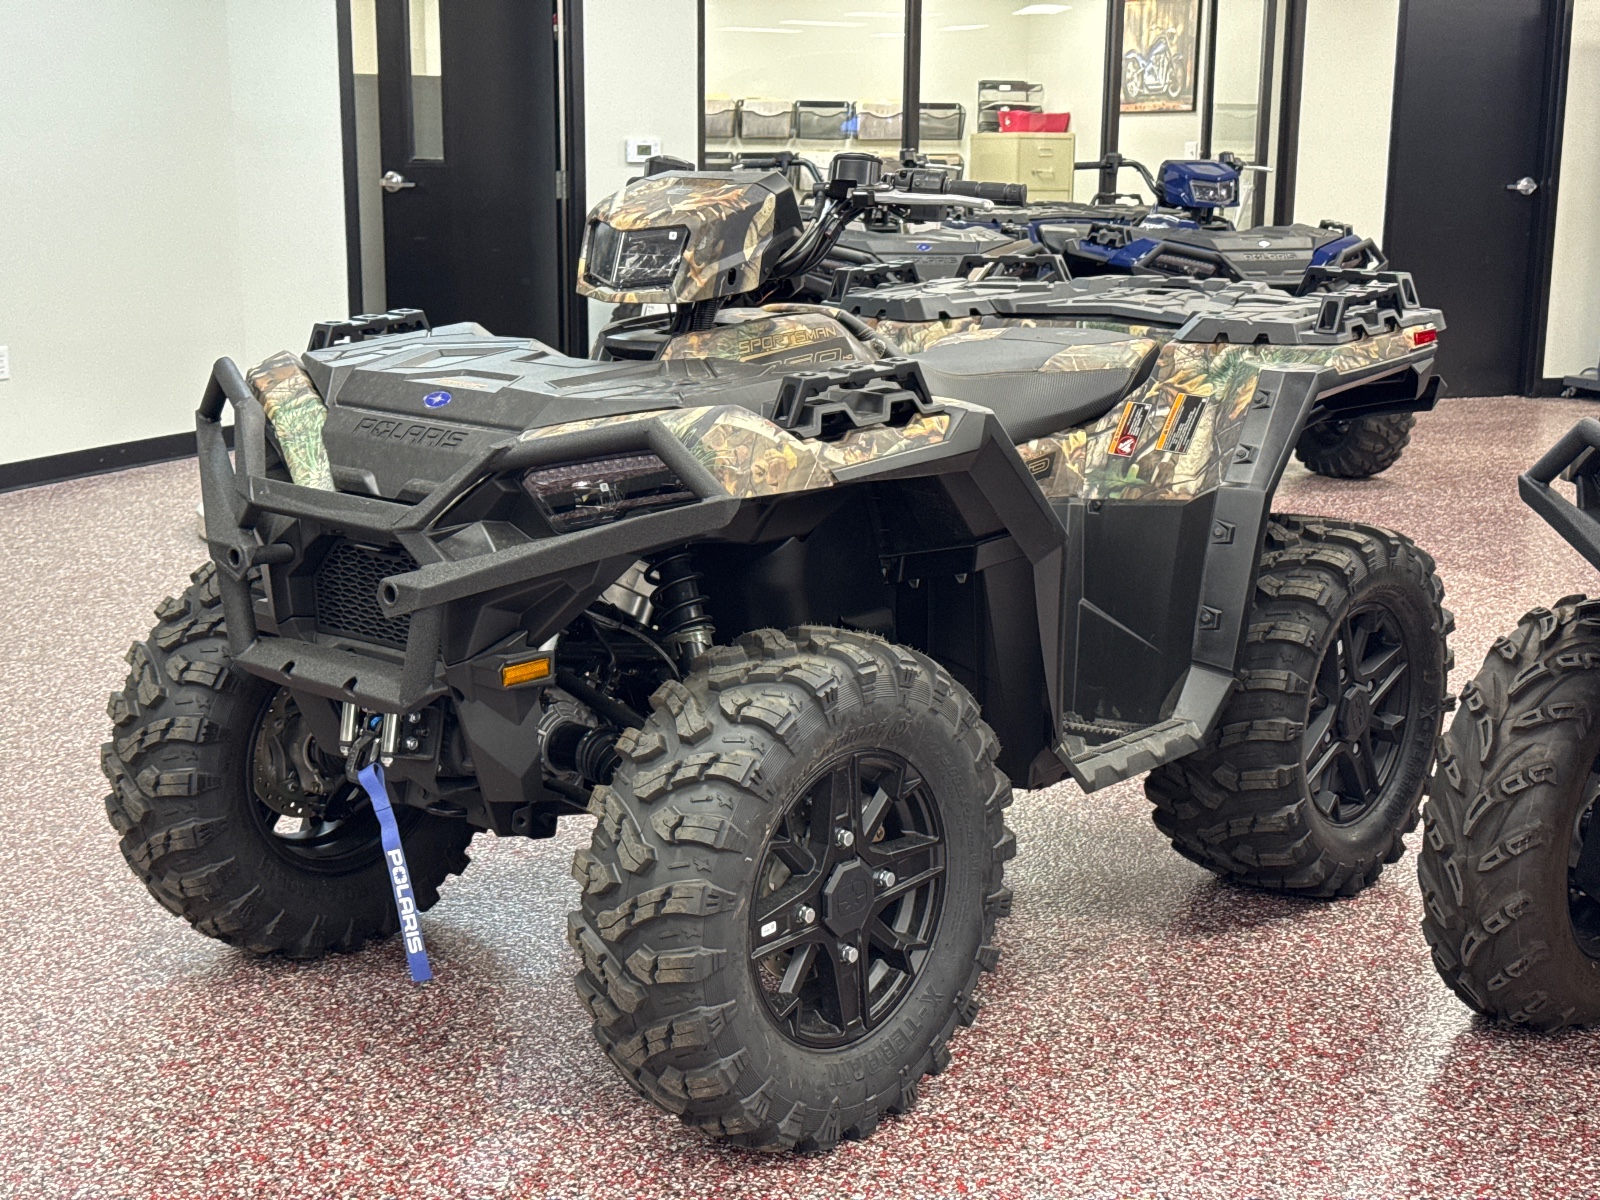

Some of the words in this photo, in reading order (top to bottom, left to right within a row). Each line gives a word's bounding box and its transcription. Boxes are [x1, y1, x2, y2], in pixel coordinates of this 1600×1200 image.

[1243, 252, 1298, 260] POLARIS
[739, 325, 837, 354] SPORTSMAN
[352, 417, 469, 447] POLARIS
[387, 848, 423, 954] POLARIS
